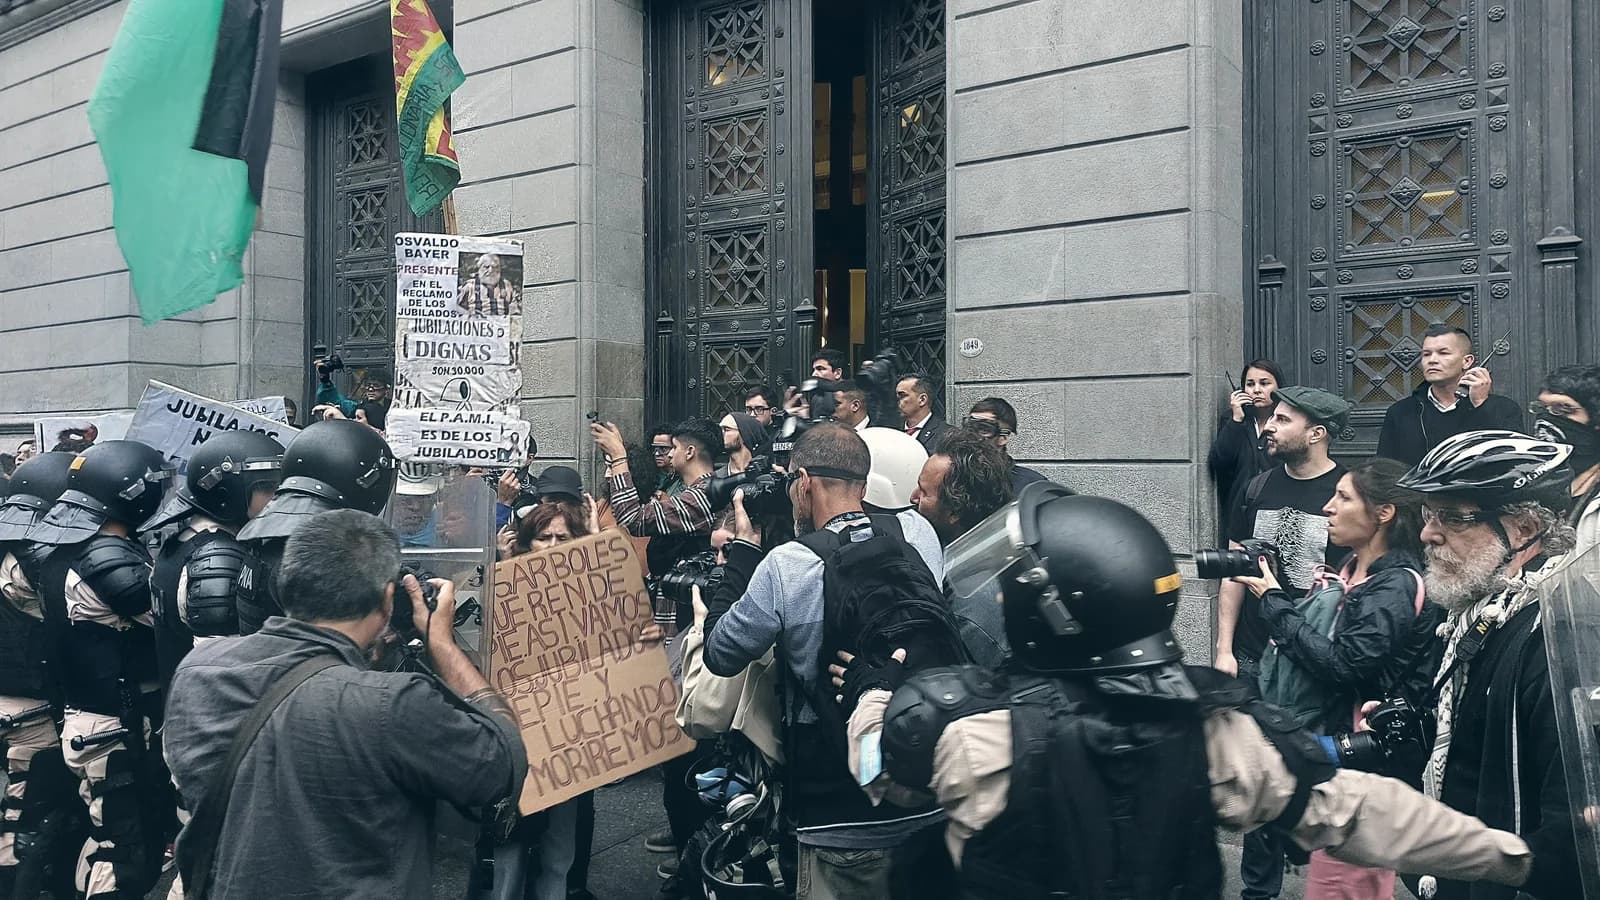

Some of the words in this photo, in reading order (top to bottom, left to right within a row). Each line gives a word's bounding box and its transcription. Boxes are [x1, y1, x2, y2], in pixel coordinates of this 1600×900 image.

[395, 236, 459, 248] OSVALDO
[404, 248, 450, 259] BAYER
[397, 264, 458, 276] PRESENTE
[412, 280, 428, 288] EN
[430, 280, 442, 289] EL
[402, 289, 453, 299] RECLAMO
[408, 299, 424, 307] DE
[425, 300, 446, 308] LOS
[398, 308, 457, 318] JUBILADOS
[412, 318, 494, 338] JUBILACIONES
[415, 340, 492, 361] DIGNAS
[963, 339, 979, 351] 1849
[432, 366, 450, 376] SON
[451, 366, 484, 376] 30.000
[420, 412, 437, 422] EL
[440, 413, 495, 425] P.A.M.I.
[421, 430, 437, 440] ES
[441, 430, 460, 441] DE
[464, 431, 492, 442] LOS
[414, 447, 497, 460] JUBILADOS
[511, 535, 629, 595] ARBOLES
[529, 708, 682, 798] MORIREMOS
